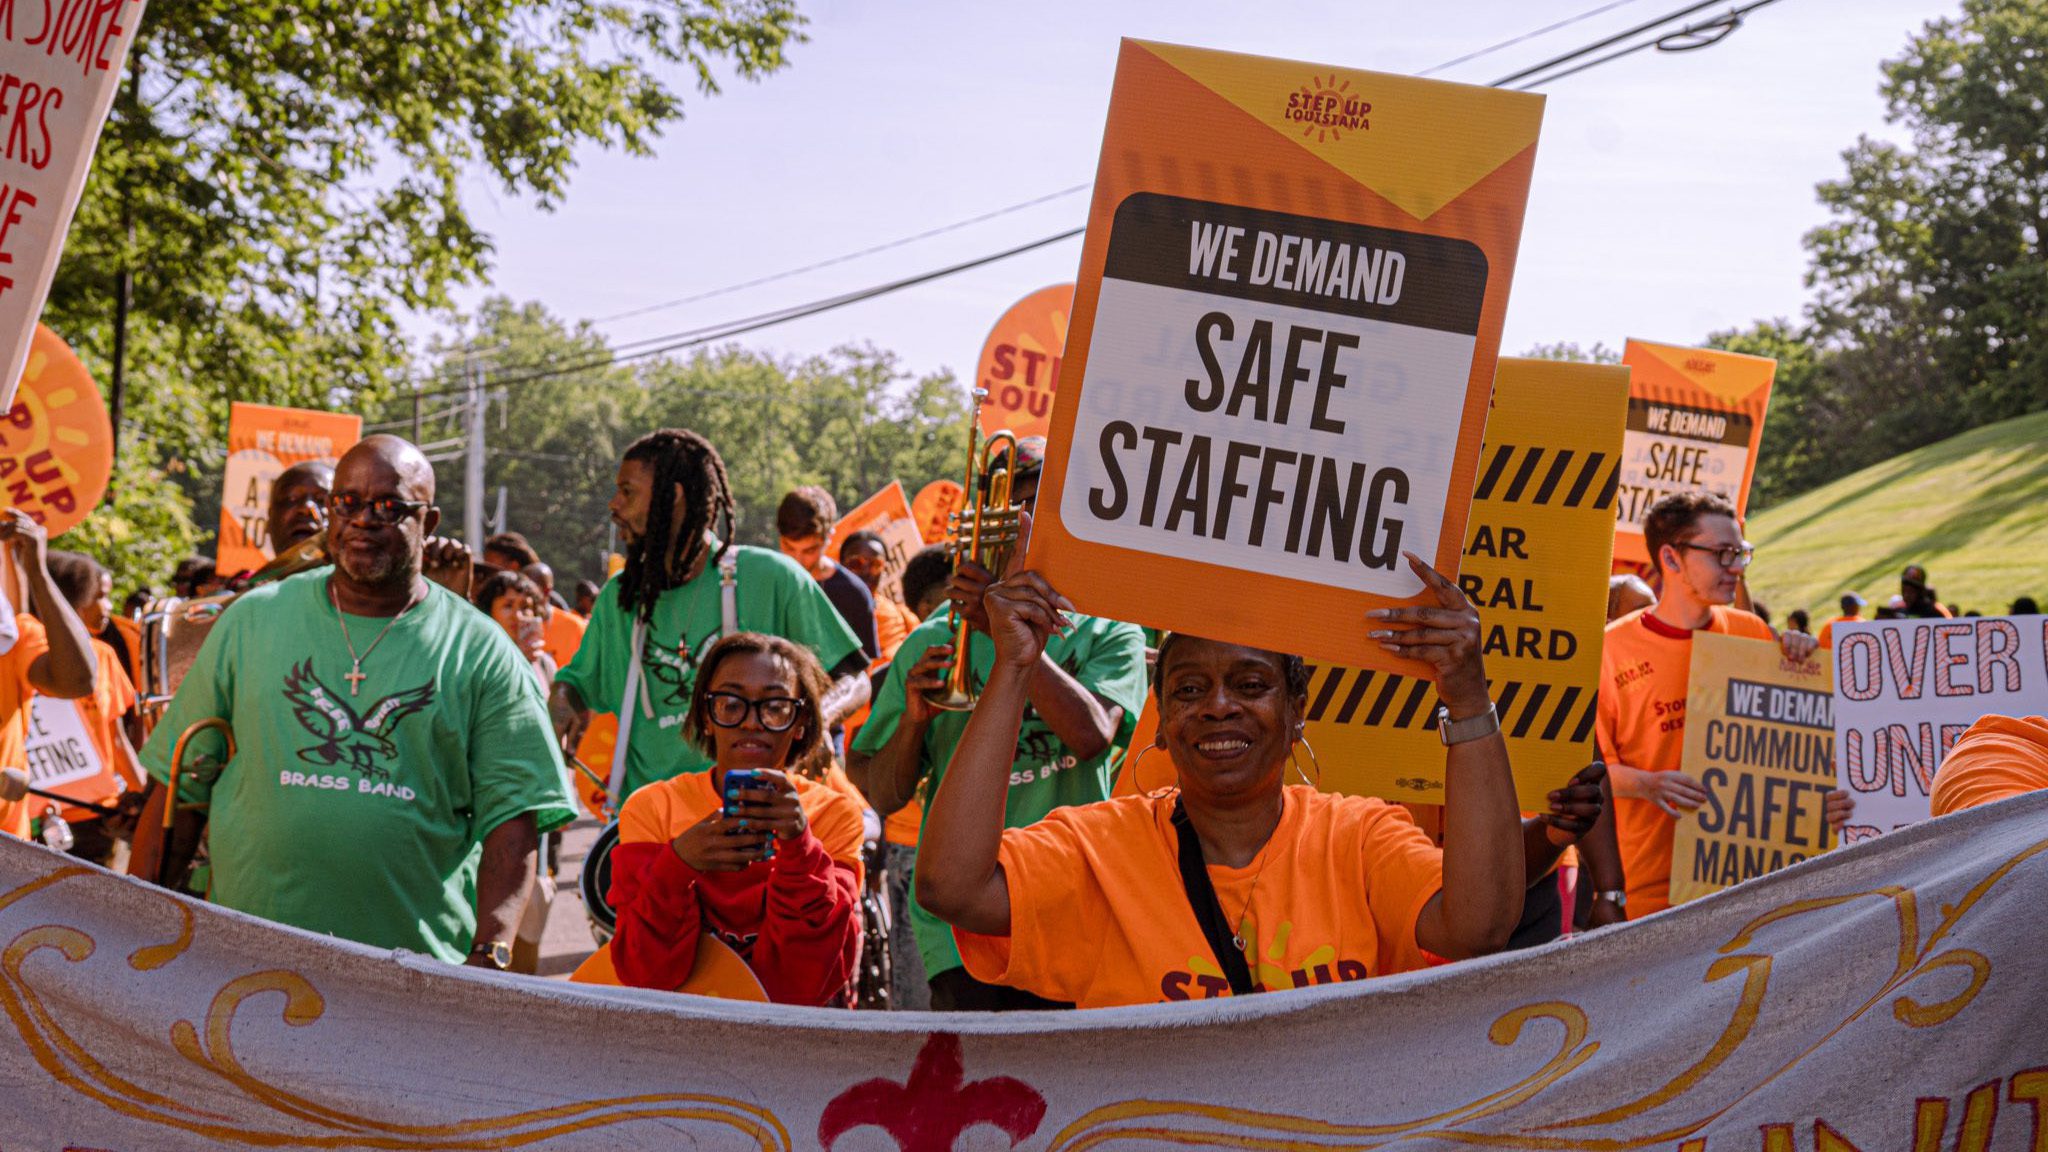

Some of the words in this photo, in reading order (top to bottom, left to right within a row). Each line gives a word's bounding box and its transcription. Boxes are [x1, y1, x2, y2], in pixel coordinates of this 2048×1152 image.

[1285, 107, 1369, 131] LOUISIANA
[1288, 92, 1337, 113] STEP
[1345, 99, 1372, 118] UP
[1188, 220, 1245, 282] WE
[1249, 231, 1406, 306] DEMAND
[1184, 311, 1361, 436] SAFE
[1647, 406, 1670, 432] WE
[1670, 412, 1727, 440] DEMAND
[1646, 442, 1708, 486] SAFE
[1088, 420, 1410, 572] STAFFING
[1463, 524, 1529, 560] AR
[1839, 619, 2022, 701] OVER
[1732, 682, 1765, 718] WE
[1706, 719, 1836, 778] COMMUN
[279, 769, 350, 791] BRASS
[358, 778, 416, 801] BAND
